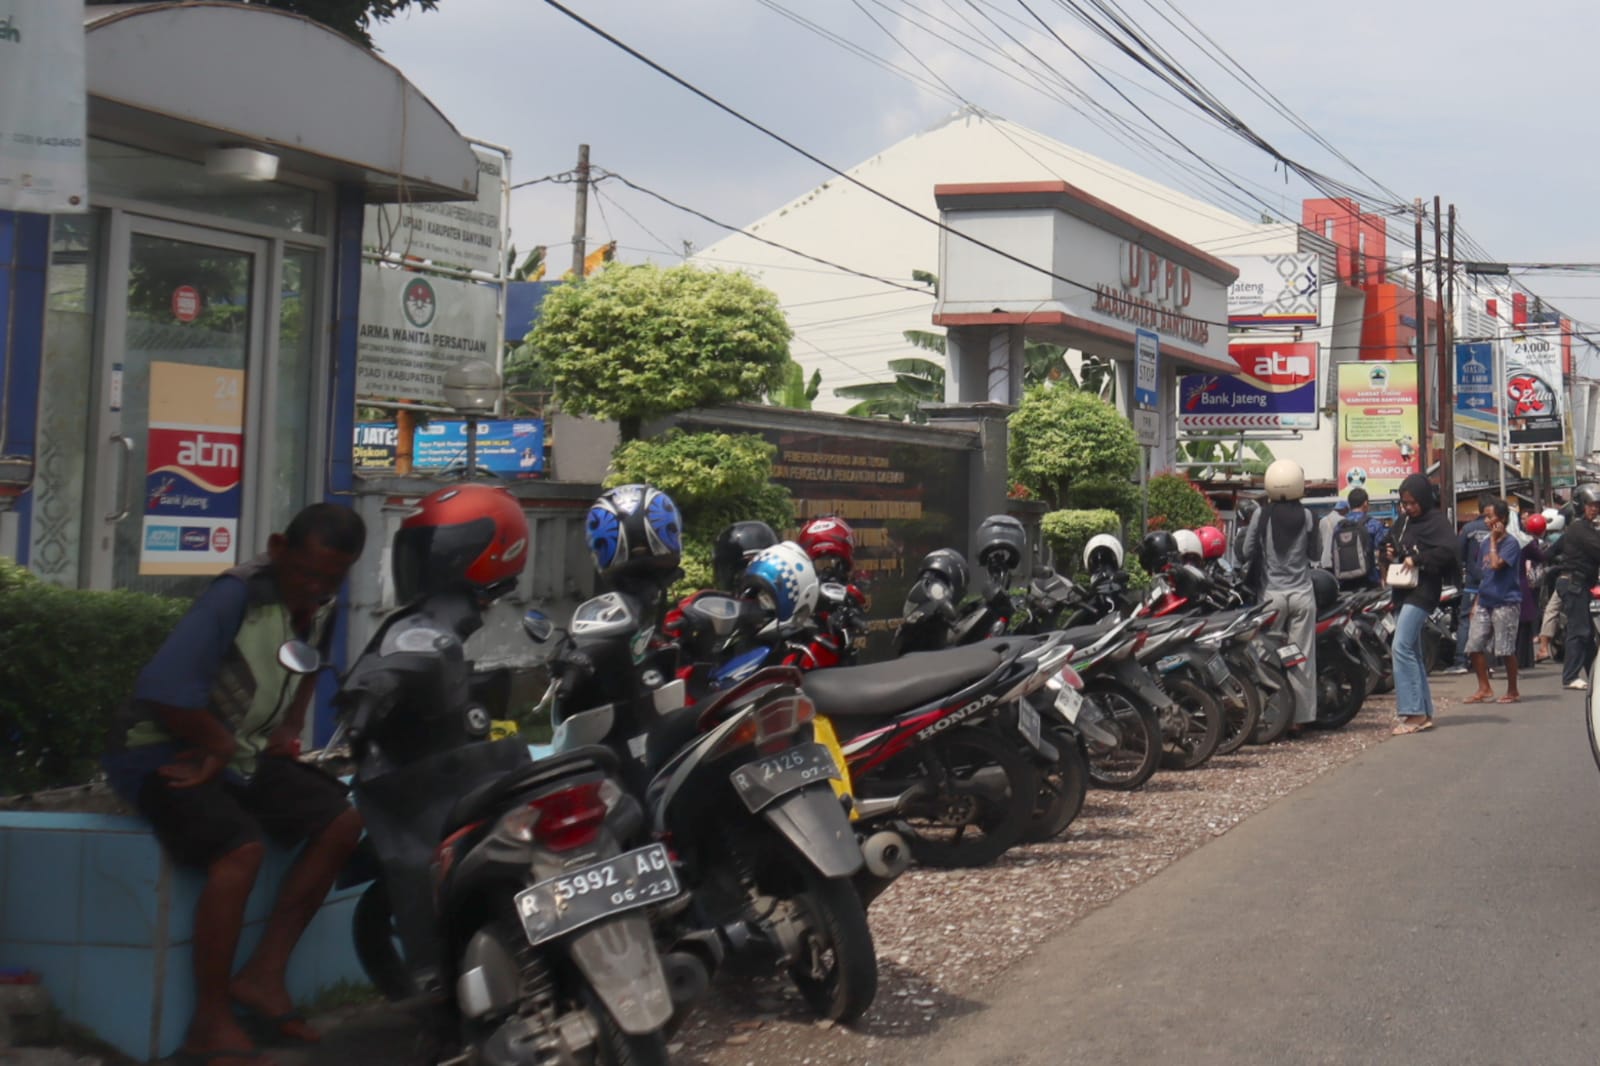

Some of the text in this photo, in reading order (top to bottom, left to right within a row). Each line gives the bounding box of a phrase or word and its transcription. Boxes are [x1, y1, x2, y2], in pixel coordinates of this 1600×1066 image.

[1121, 240, 1191, 306] UPPD
[360, 324, 487, 353] ARMA WANITA PERSATUAN
[214, 376, 239, 398] 24
[1201, 392, 1268, 407] Bank Jateng
[177, 434, 238, 468] atm
[917, 694, 998, 741] HONDA
[736, 751, 804, 791] R 2126
[521, 894, 540, 918] R
[557, 865, 620, 900] 5992
